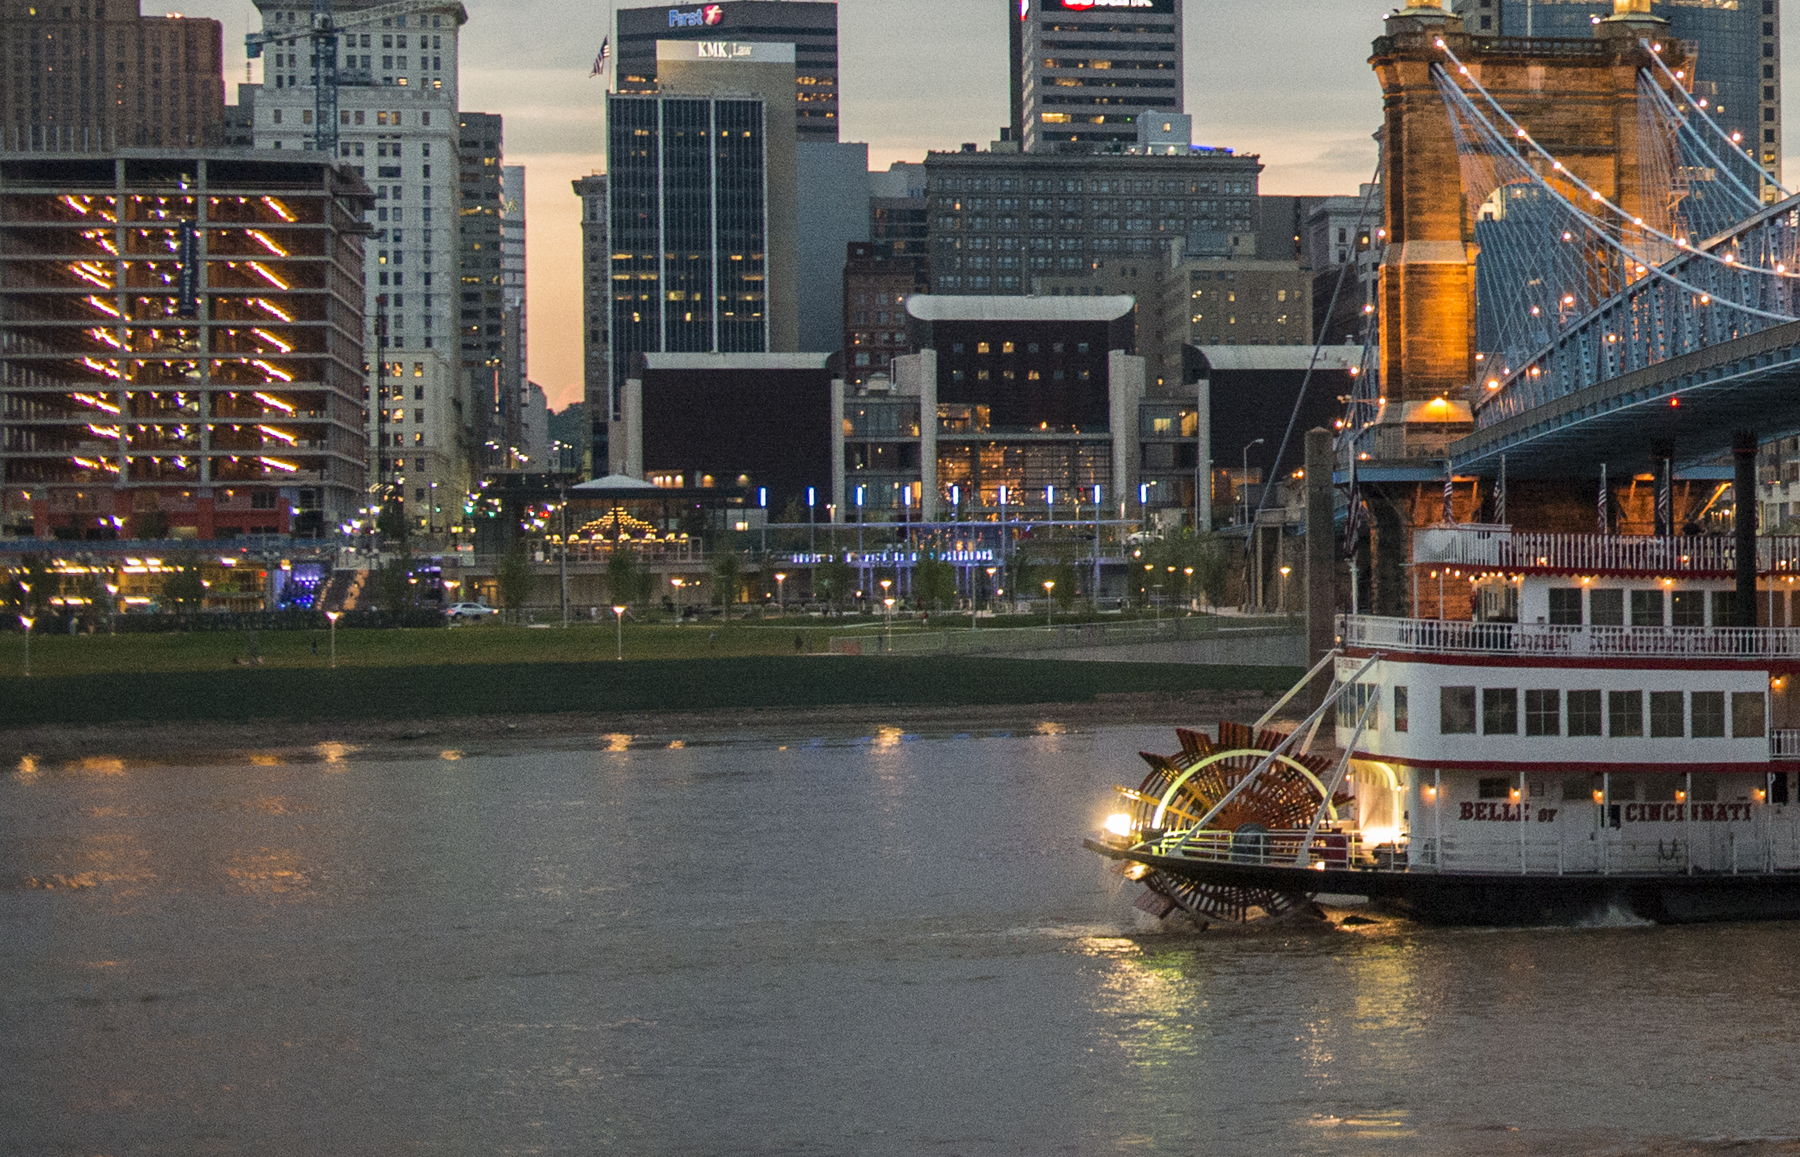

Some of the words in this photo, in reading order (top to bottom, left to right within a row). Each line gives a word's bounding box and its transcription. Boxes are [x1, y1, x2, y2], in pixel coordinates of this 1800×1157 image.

[668, 8, 703, 27] First
[698, 42, 727, 57] KMK
[732, 43, 752, 56] Law
[1459, 802, 1530, 821] BELLE
[1625, 803, 1752, 822] CINCINNATI
